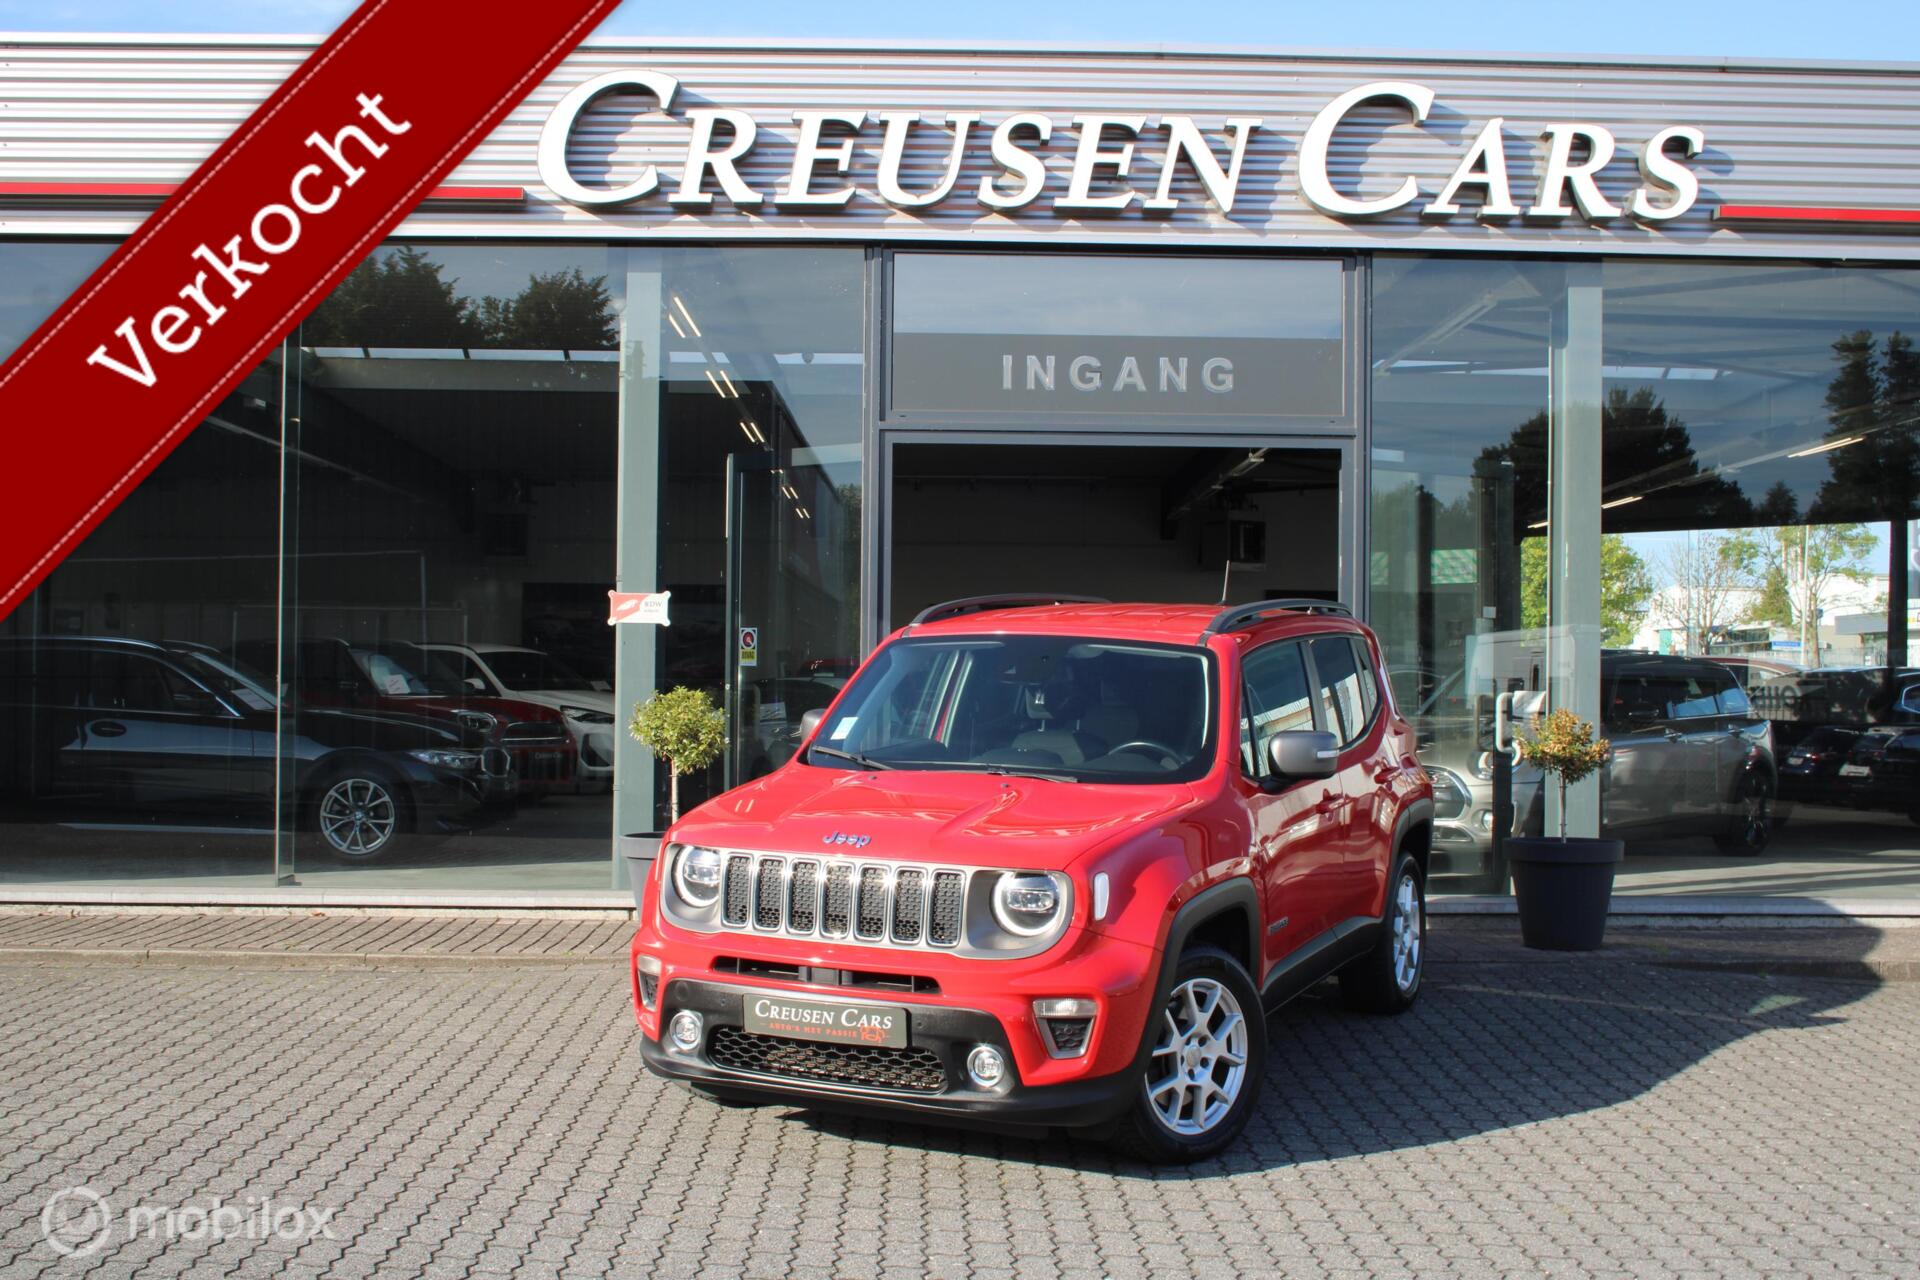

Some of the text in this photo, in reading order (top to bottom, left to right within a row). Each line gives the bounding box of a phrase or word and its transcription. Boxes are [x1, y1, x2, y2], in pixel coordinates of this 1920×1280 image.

[537, 69, 1705, 221] CREUSEN CARS
[1002, 354, 1234, 393] INGANG
[822, 831, 872, 848] Jeep
[754, 999, 893, 1030] CREUSEN CARS
